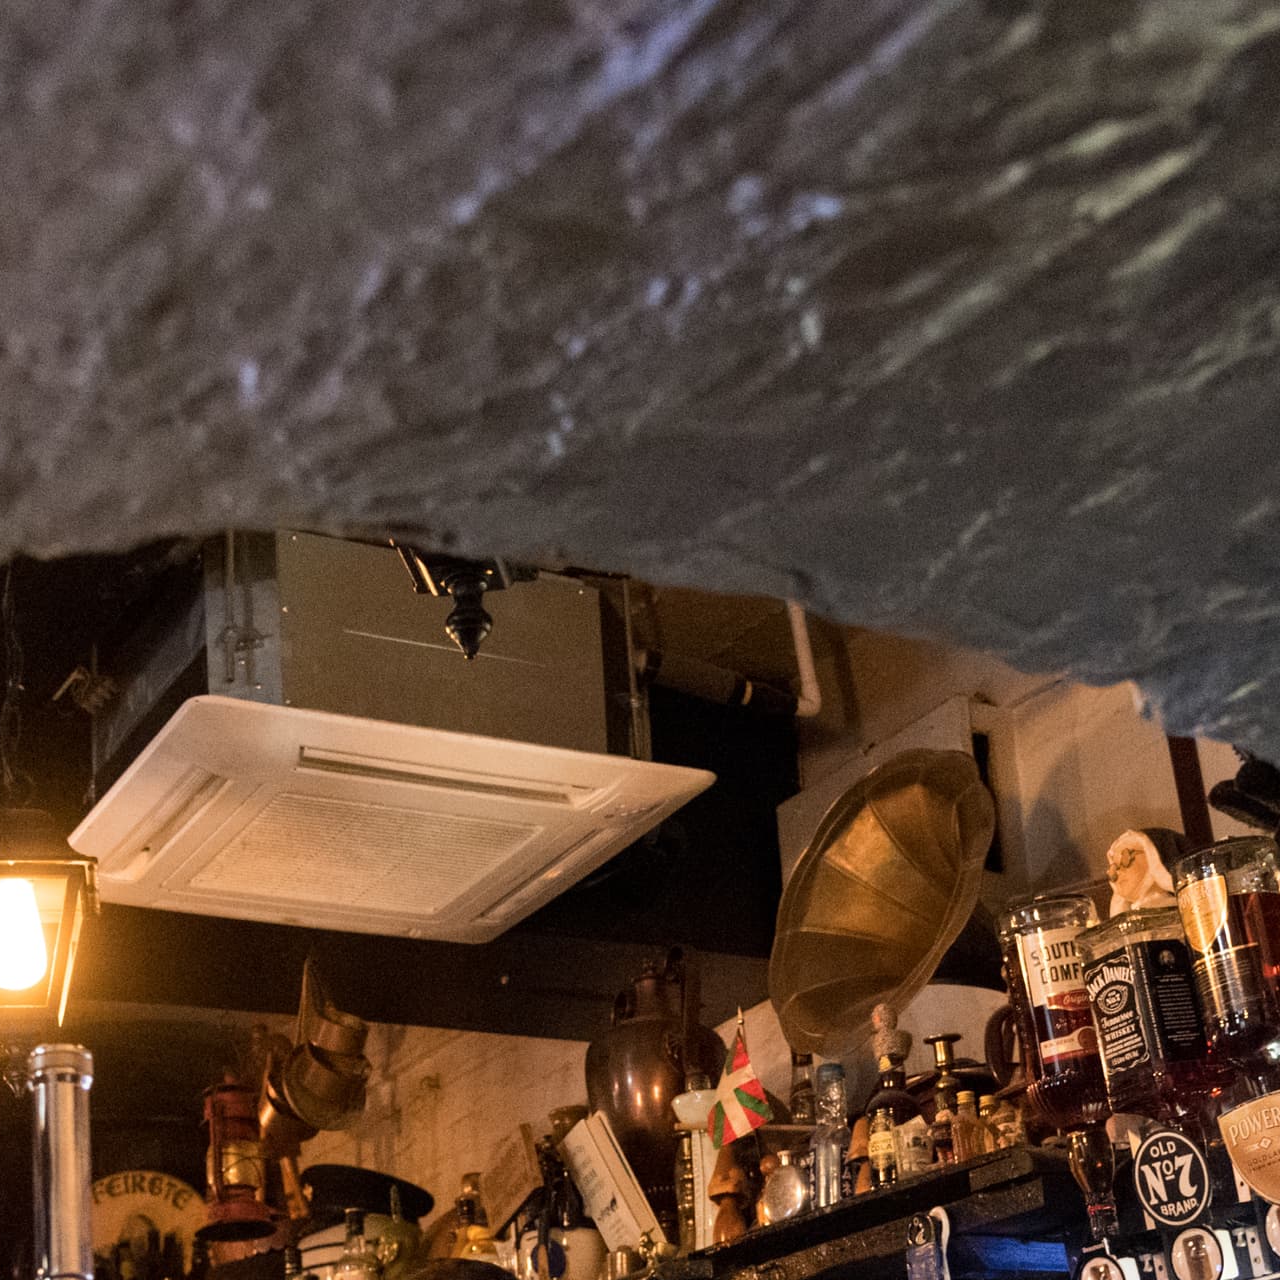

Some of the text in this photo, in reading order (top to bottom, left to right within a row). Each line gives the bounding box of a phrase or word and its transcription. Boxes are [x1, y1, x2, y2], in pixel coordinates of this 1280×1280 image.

[1086, 972, 1108, 1002] JACK
[1104, 1024, 1136, 1041] WHISKEY
[1149, 1141, 1176, 1158] OLD
